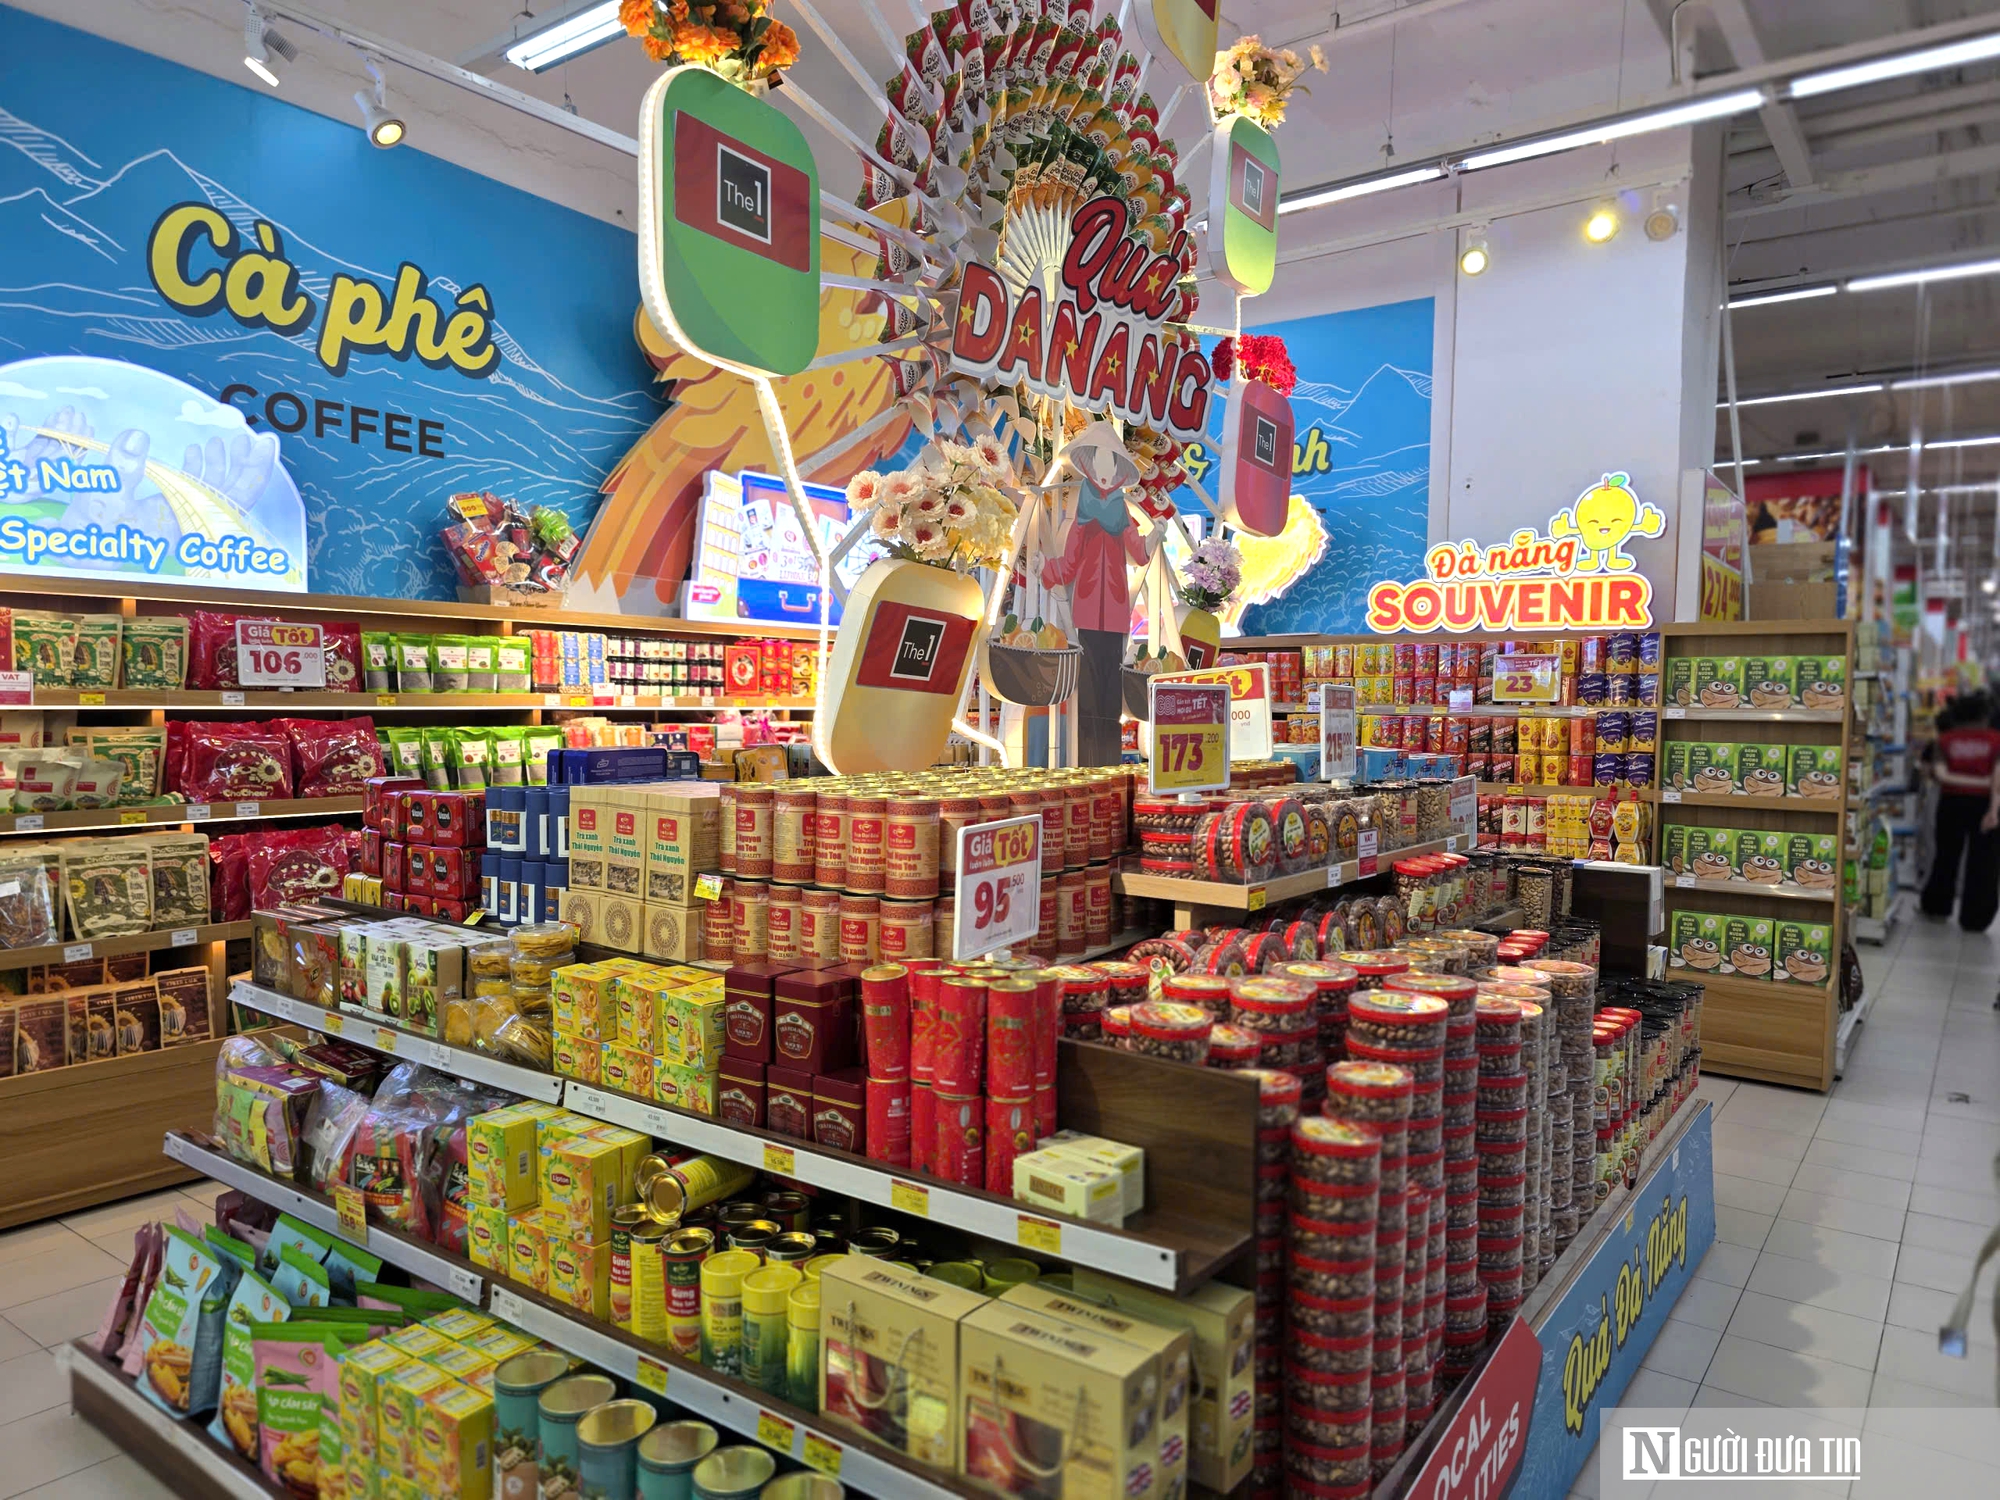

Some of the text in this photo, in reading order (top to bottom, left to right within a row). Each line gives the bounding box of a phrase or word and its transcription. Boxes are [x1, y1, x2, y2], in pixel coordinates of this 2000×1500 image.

[149, 203, 498, 373] Cà phê
[219, 383, 445, 459] COFFEE
[41, 460, 118, 490] Nam
[0, 519, 288, 574] Specialty Coffee
[1430, 544, 1481, 579] Đà
[1371, 579, 1646, 627] SOUVENIR
[248, 625, 308, 644] Giá Tốt
[1, 673, 20, 681] VAT
[249, 650, 302, 675] 106
[1505, 675, 1534, 693] 23
[1159, 732, 1204, 773] 173
[970, 823, 1029, 861] Giá Tốt
[974, 876, 1012, 930] 95
[609, 1068, 623, 1077] Lipton
[662, 1083, 677, 1093] Lipton
[552, 1175, 570, 1185] Lipton
[557, 1262, 574, 1274] Lipton
